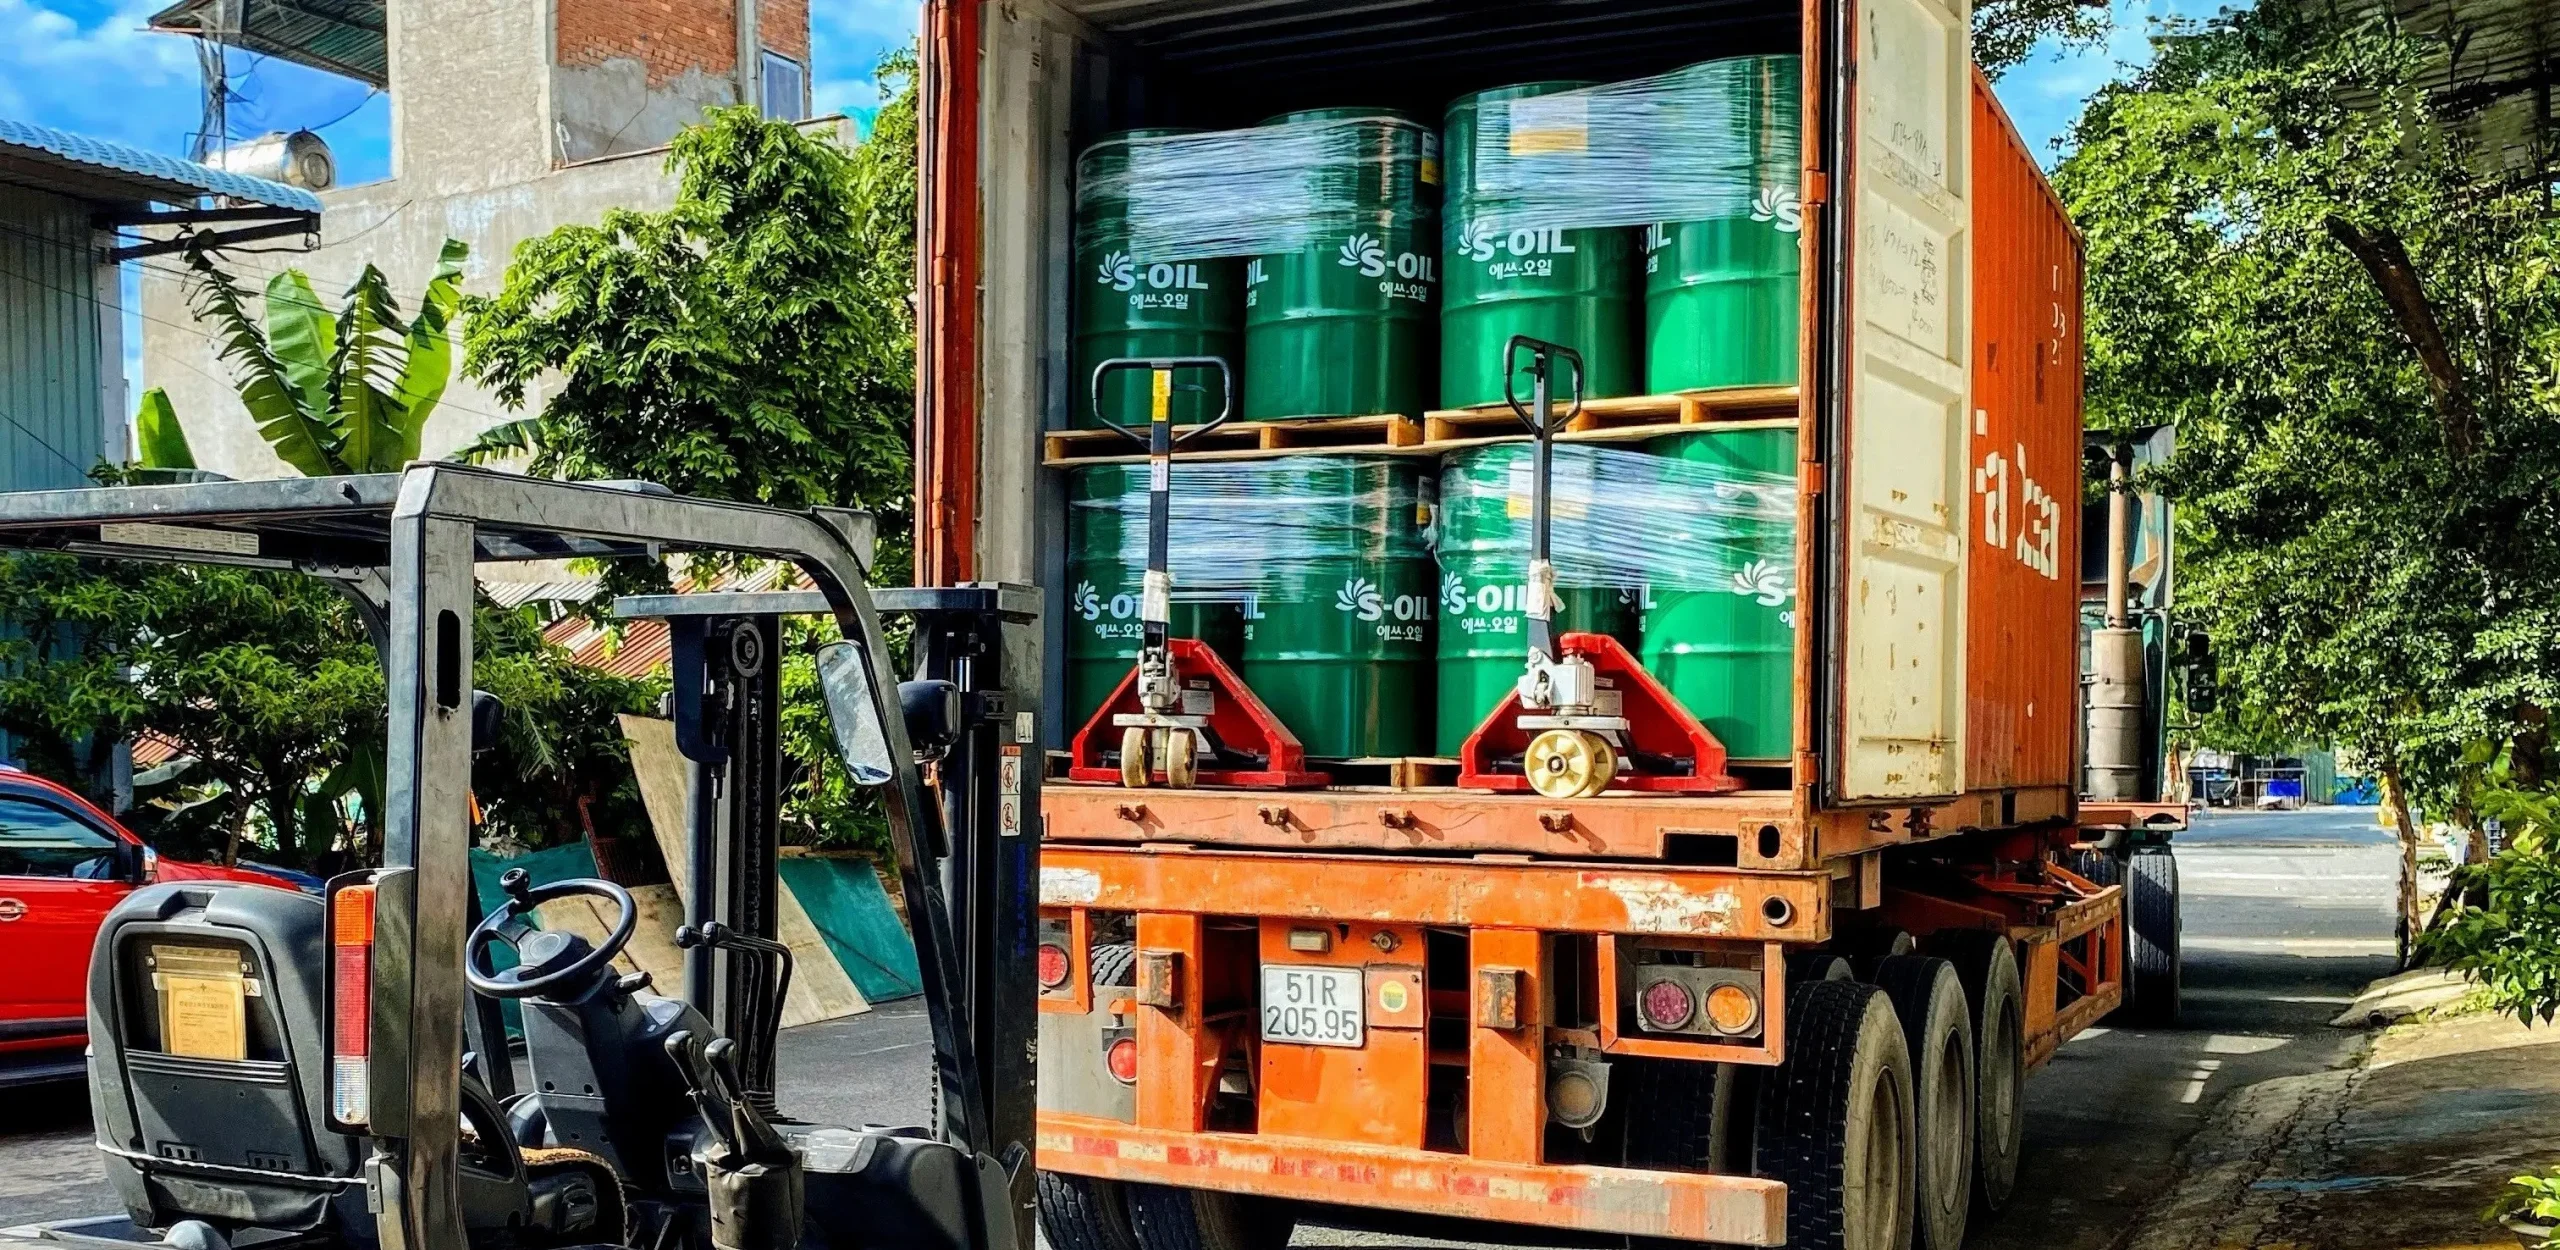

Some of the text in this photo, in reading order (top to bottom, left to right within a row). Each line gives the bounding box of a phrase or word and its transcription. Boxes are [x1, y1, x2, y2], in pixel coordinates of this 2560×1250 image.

[1471, 227, 1576, 262] S-OIL
[1112, 263, 1209, 292] S-OIL
[1359, 248, 1436, 282] S-OIL
[1488, 258, 1553, 280] 에쓰-오일
[1129, 293, 1189, 310] 에쓰-오일
[1378, 281, 1427, 302] 에쓰-오일
[1356, 593, 1432, 621] S-OIL
[1376, 625, 1423, 642] 에쓰-오일
[1461, 616, 1518, 635] 에쓰-오일
[1286, 972, 1336, 1007] 51R
[1266, 1005, 1358, 1041] 205.95
